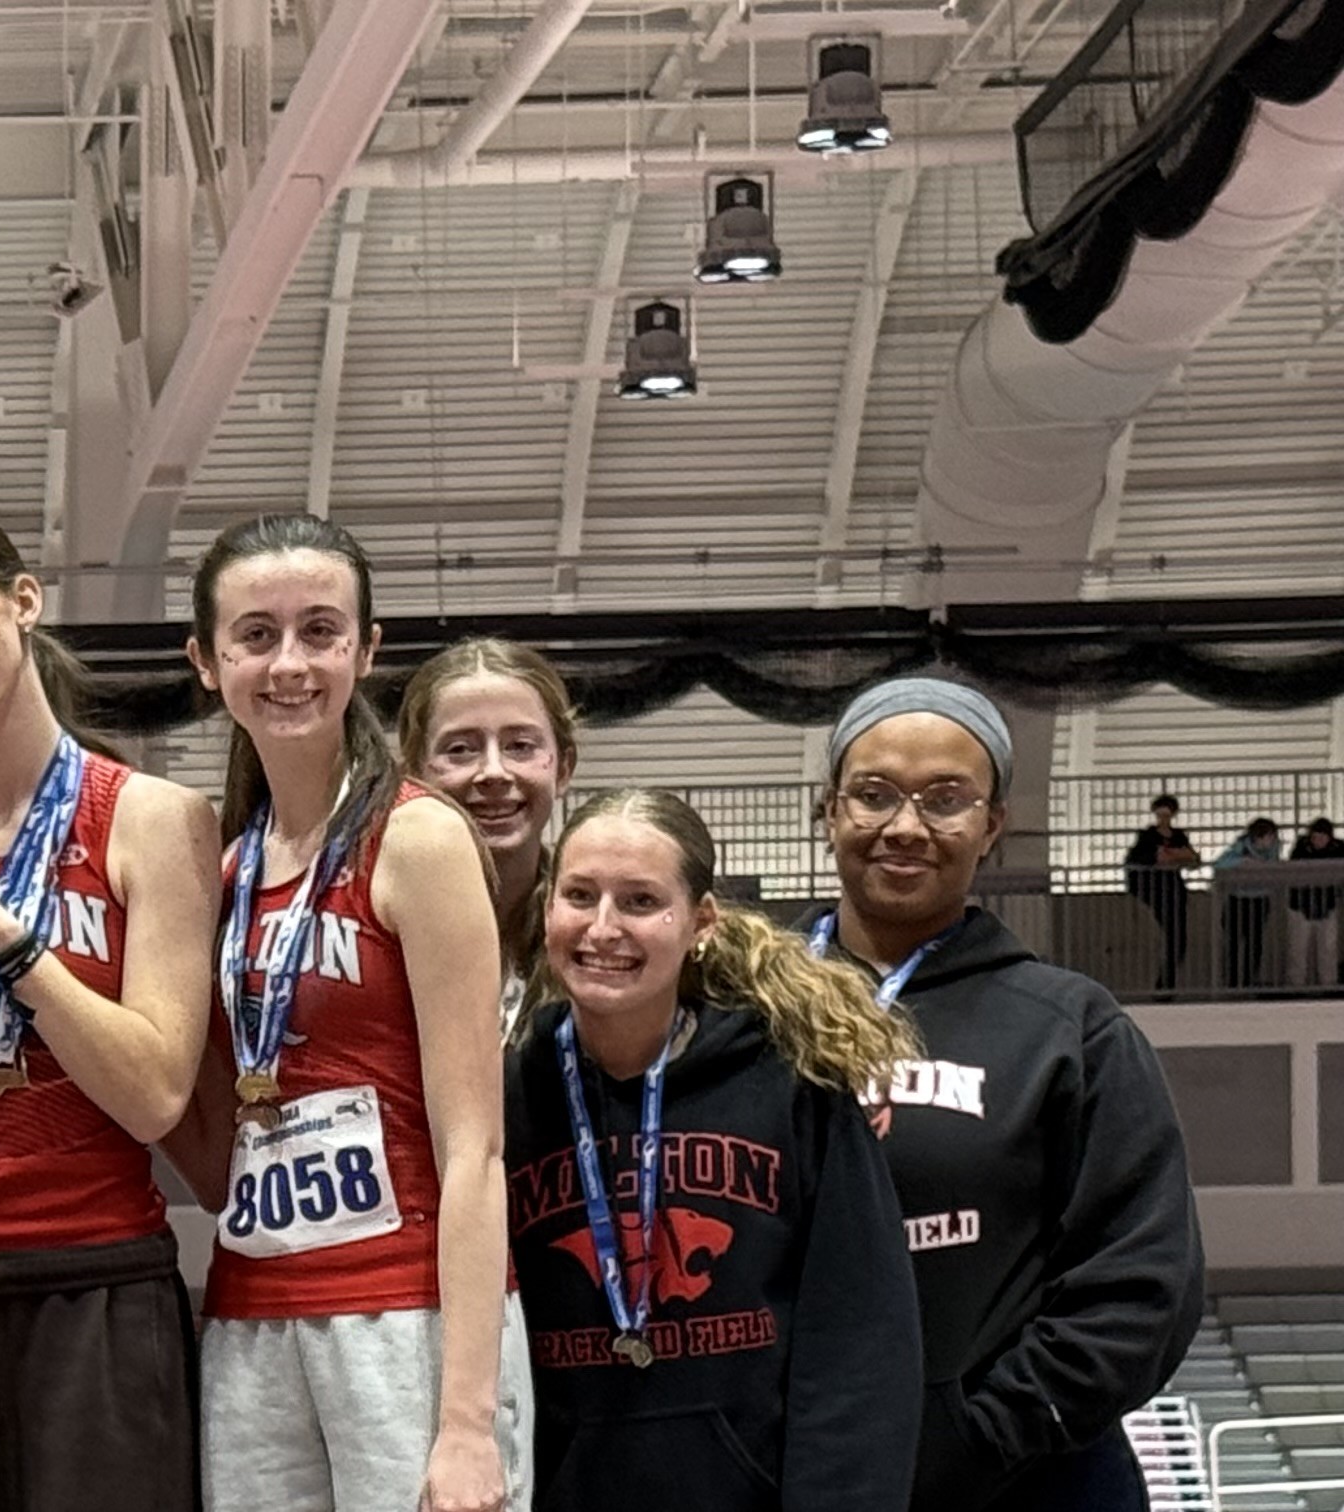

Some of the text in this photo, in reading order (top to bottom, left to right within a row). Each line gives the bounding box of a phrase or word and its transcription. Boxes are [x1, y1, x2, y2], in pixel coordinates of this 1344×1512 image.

[227, 1144, 382, 1238] 8058
[903, 1209, 981, 1252] IELD
[531, 1326, 612, 1369] RACK
